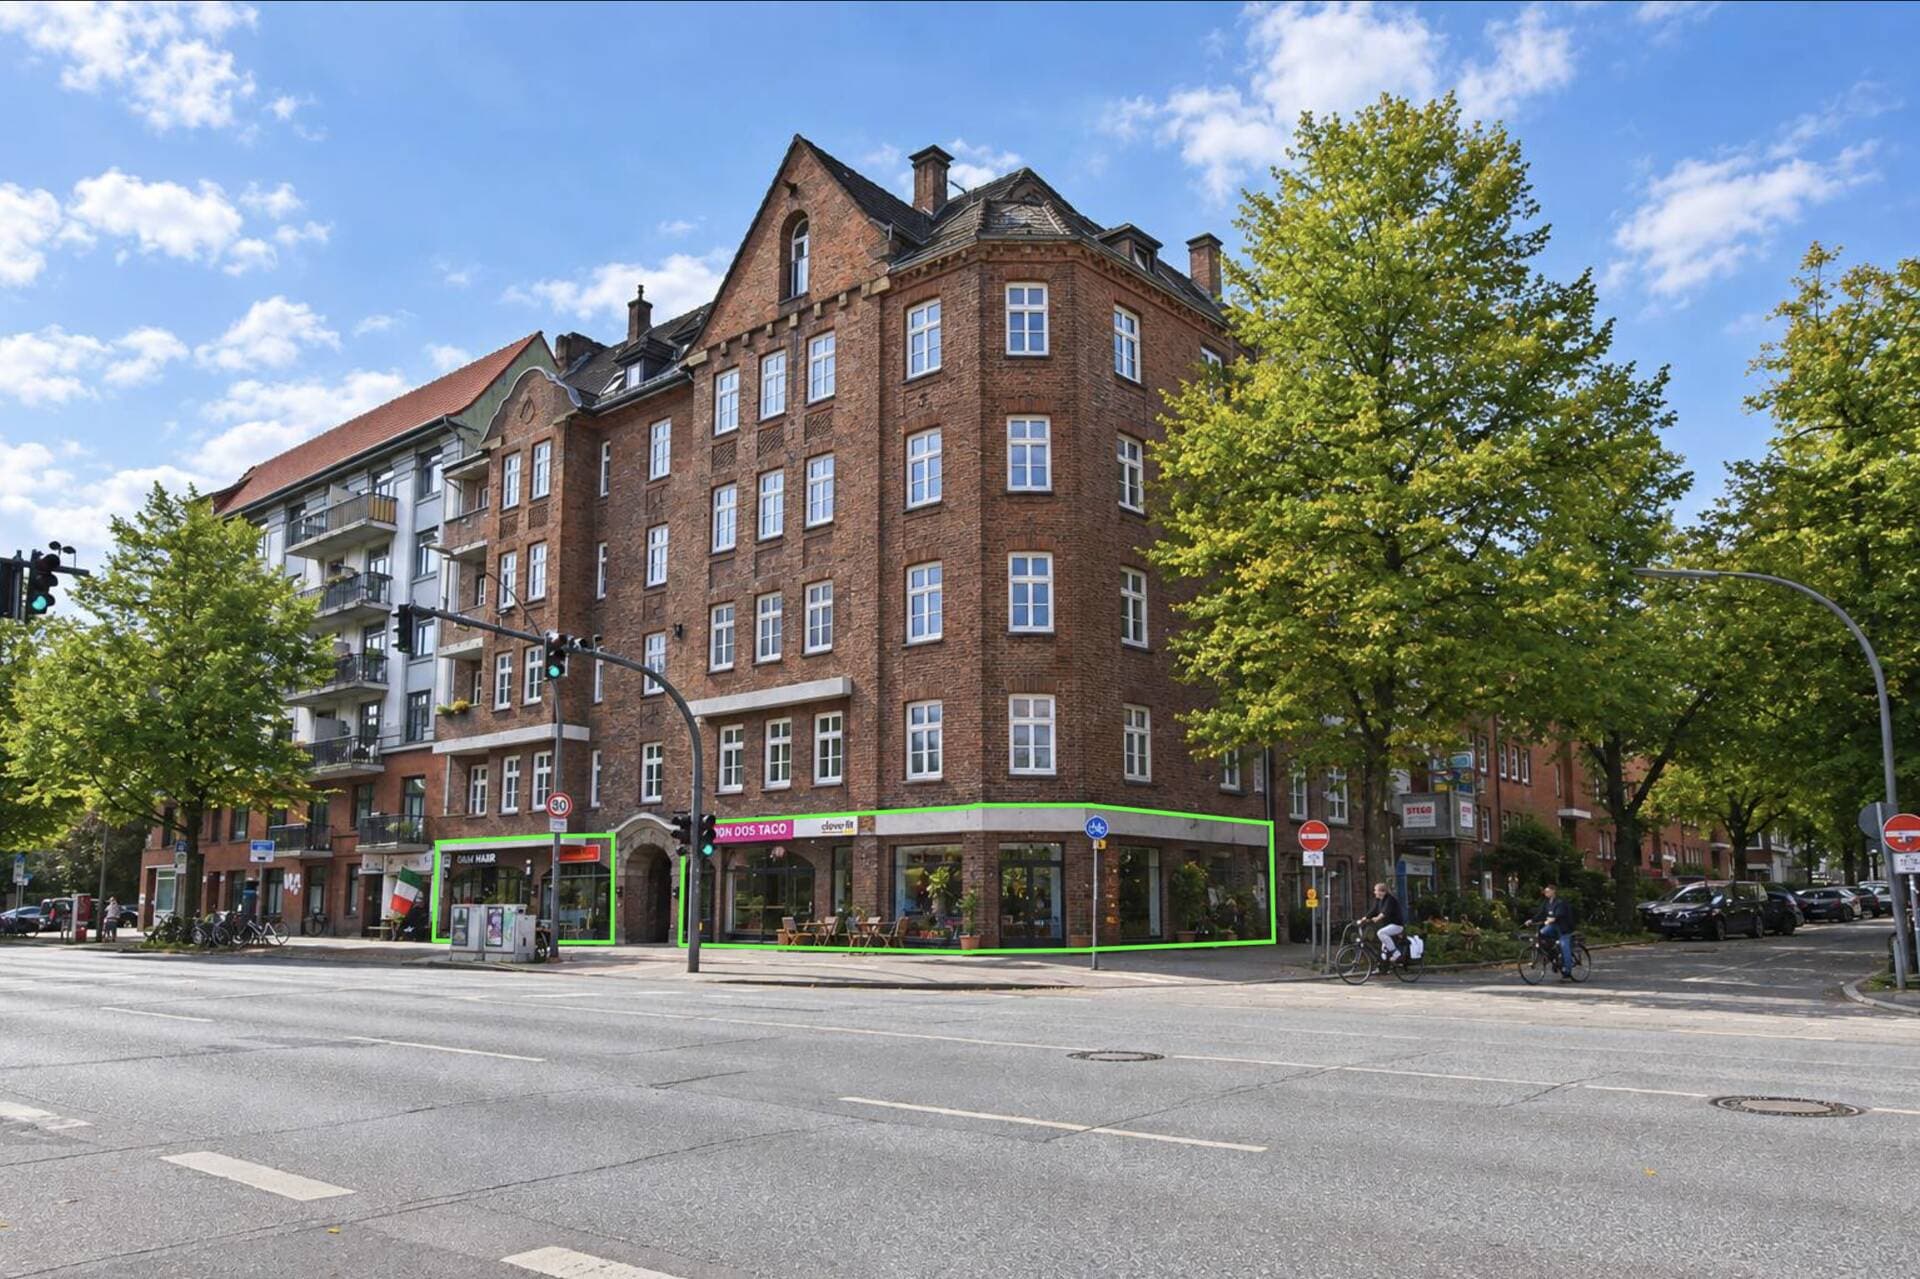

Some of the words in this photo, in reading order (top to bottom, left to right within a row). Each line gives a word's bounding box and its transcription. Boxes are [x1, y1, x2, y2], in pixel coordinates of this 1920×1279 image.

[552, 799, 567, 811] 30
[758, 823, 787, 835] TACO
[475, 852, 496, 863] HAIR
